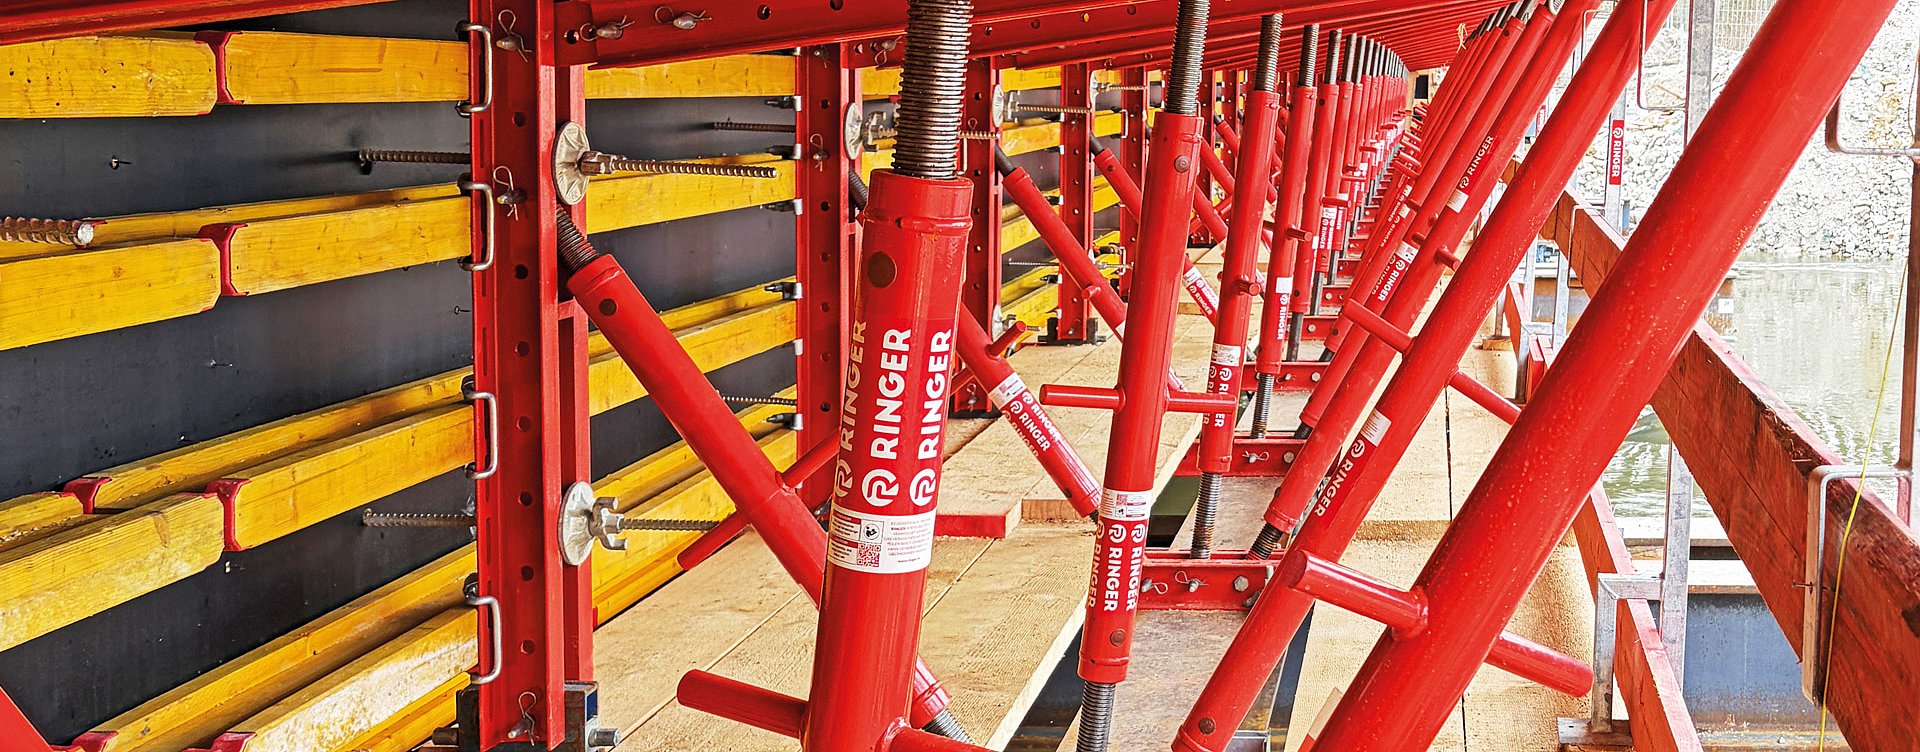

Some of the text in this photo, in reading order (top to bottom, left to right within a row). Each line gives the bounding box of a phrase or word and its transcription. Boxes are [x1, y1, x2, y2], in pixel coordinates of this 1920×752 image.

[1466, 135, 1494, 175] RINGER
[1611, 140, 1622, 178] RINGER
[1377, 269, 1400, 301] RINGER
[1276, 306, 1288, 340] RINGER
[840, 320, 867, 452] RINGER
[870, 328, 912, 460] RINGER
[917, 328, 952, 460] RINGER
[1018, 412, 1051, 452] RINGER
[1314, 459, 1354, 517] RINGER
[1103, 547, 1123, 612] RINGER
[1126, 546, 1142, 612] RINGER
